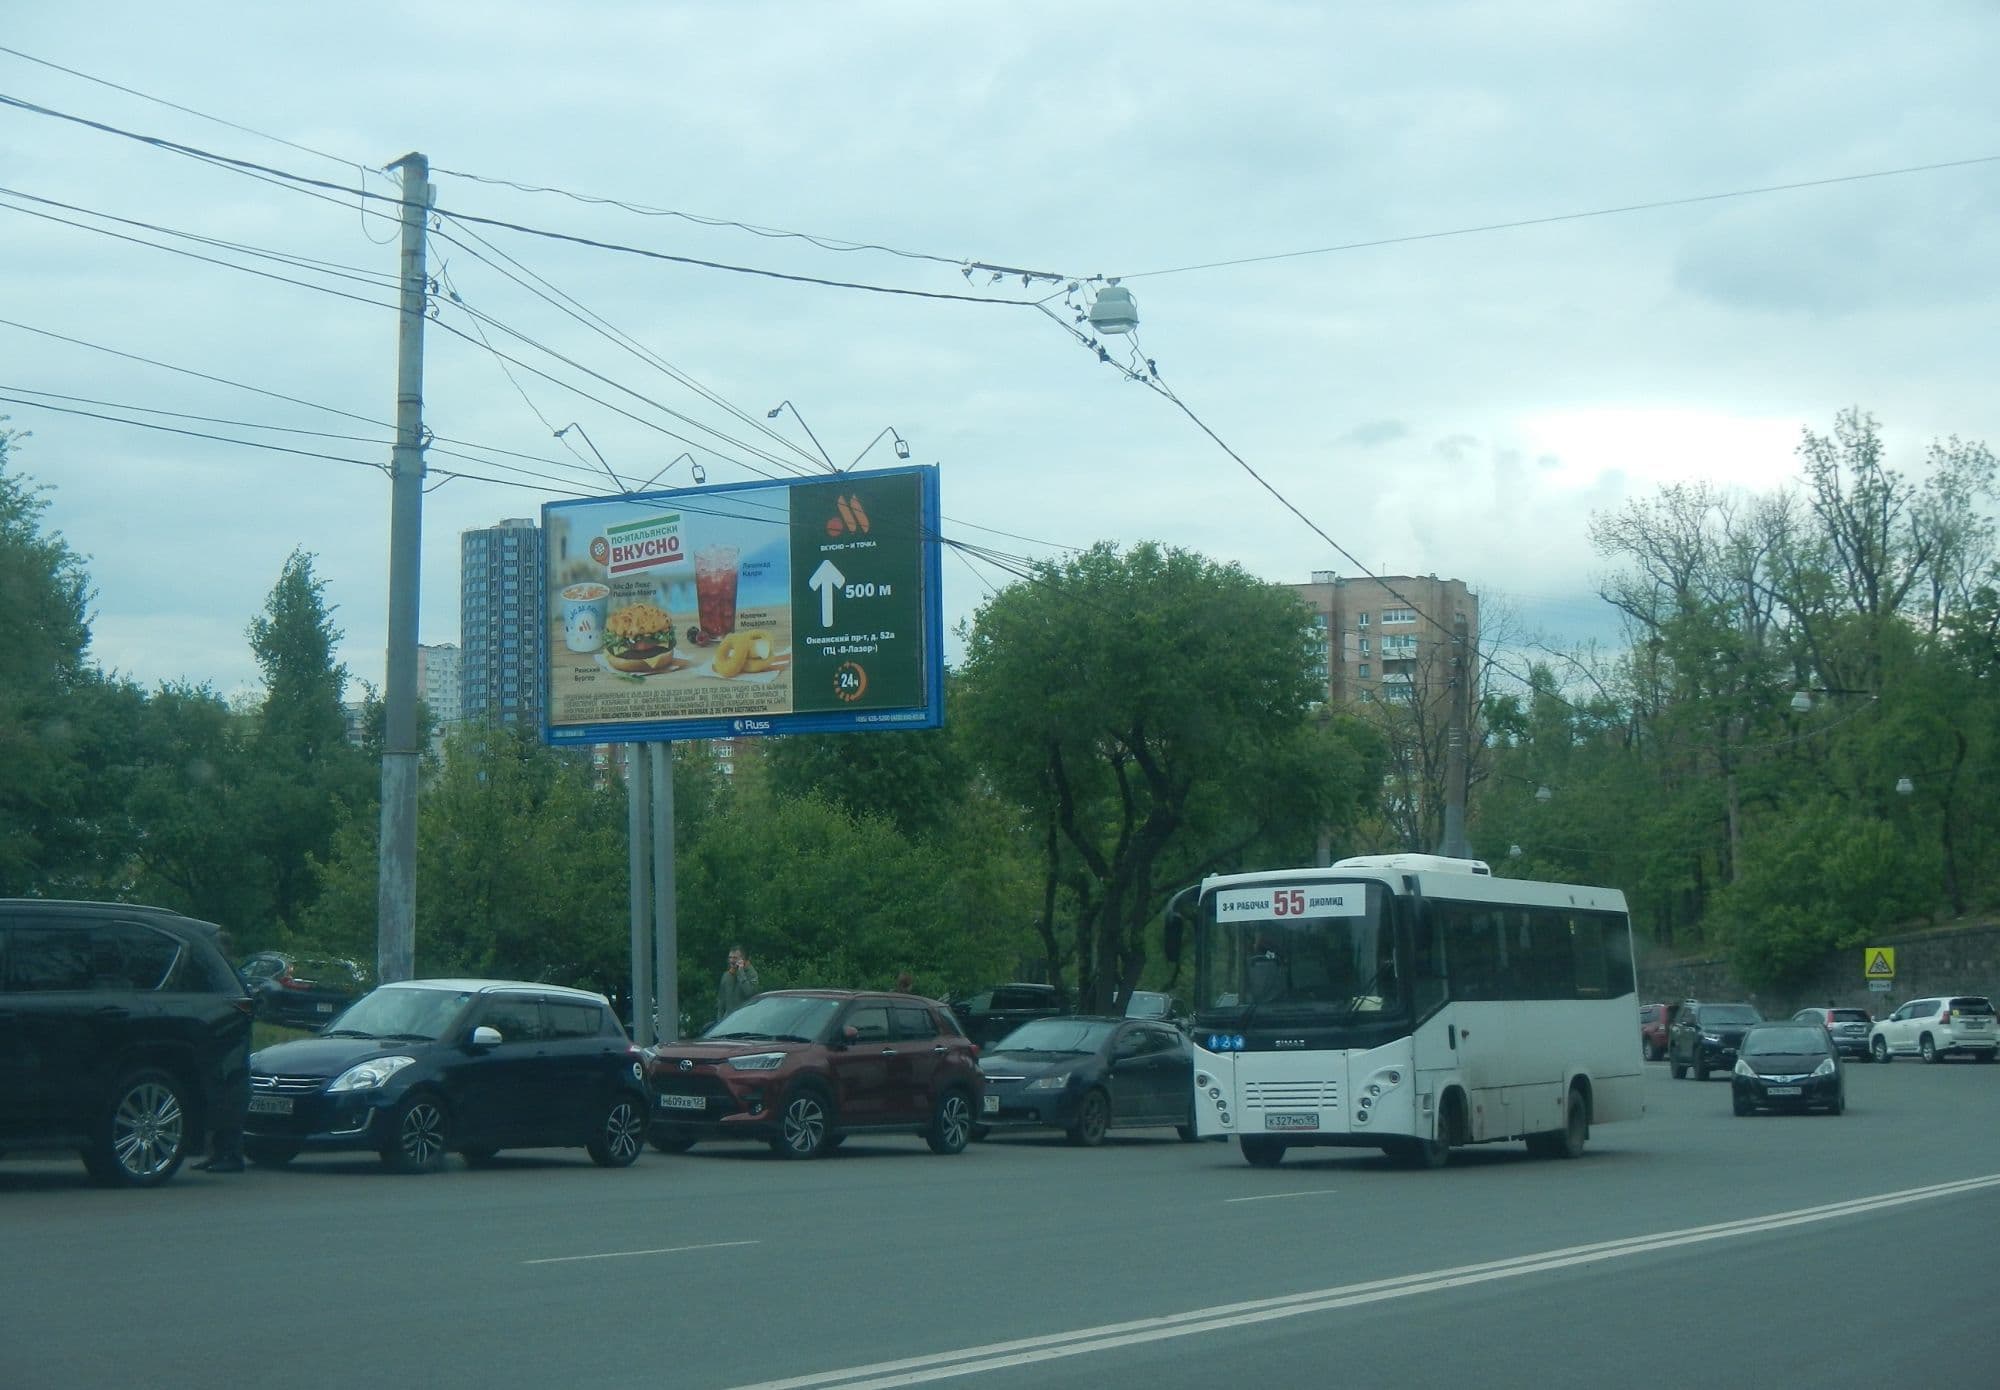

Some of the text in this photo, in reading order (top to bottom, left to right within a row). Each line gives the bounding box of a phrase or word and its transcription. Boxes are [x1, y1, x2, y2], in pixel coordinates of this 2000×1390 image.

[611, 525, 678, 544] ПО-ИТАЛЬЯНСКИ
[612, 536, 679, 562] ВКУСНО
[820, 543, 844, 551] ВКУСНО
[845, 583, 875, 598] 500
[806, 634, 849, 644] Океанский
[745, 720, 770, 730] Russ
[1222, 890, 1343, 916] 3-Я РАБОЧАЯ 55 ДИОМИД
